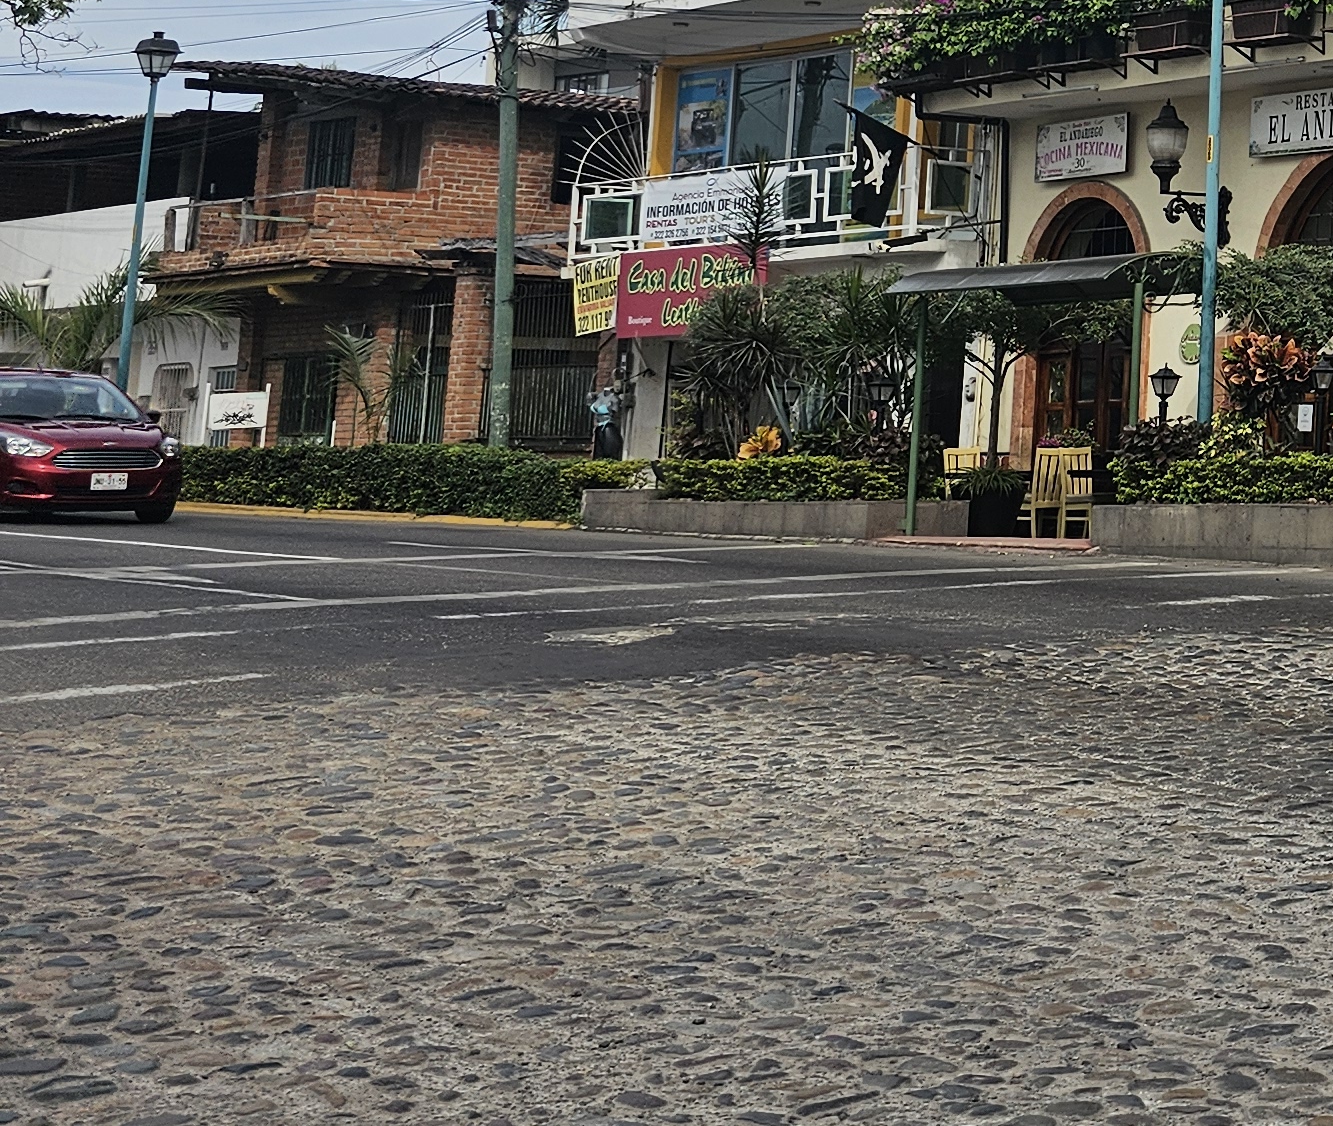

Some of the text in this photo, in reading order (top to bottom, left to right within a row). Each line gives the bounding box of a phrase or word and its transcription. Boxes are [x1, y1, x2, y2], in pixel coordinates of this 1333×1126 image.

[1060, 126, 1104, 142] EL ANDARIEGO
[1268, 114, 1292, 145] EL
[1039, 141, 1123, 169] COCINA MEXICANA
[1074, 157, 1085, 169] 30
[646, 199, 715, 218] INFORMACIÓN
[718, 198, 731, 211] DE
[734, 193, 781, 210] HOES
[672, 191, 705, 204] Agencia
[646, 218, 678, 229] RENTAS
[685, 214, 716, 226] TOUR'S
[575, 256, 619, 285] FOR RENT
[627, 259, 666, 294] Casa
[669, 257, 698, 294] del
[577, 279, 617, 304] PENTHOUSE
